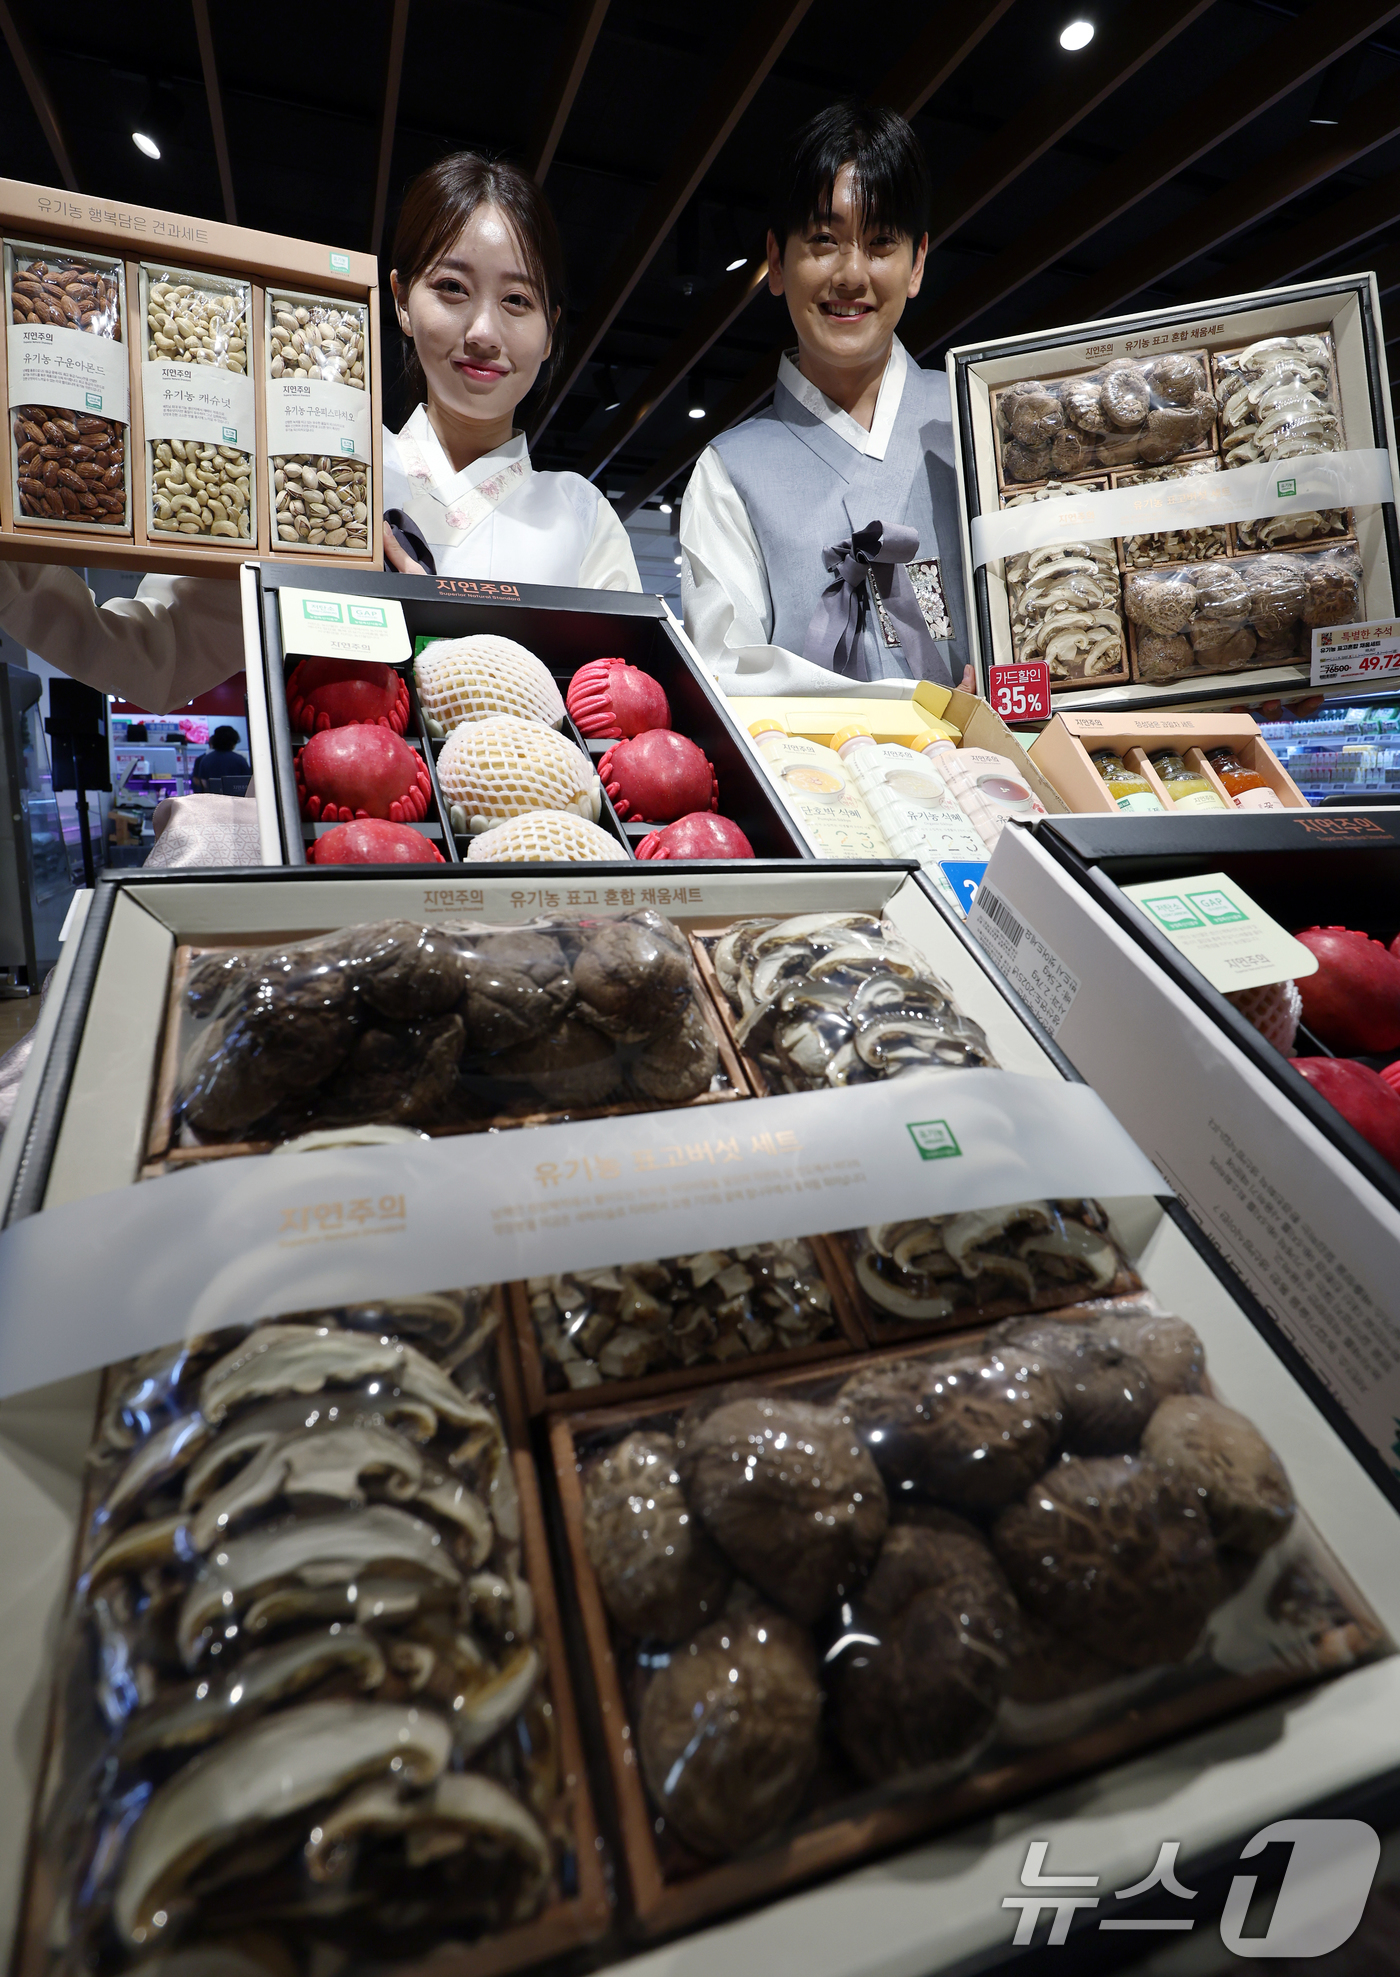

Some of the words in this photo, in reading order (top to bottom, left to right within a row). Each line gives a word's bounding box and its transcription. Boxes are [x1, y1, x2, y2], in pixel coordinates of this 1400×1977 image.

[37, 197, 83, 219] 유기농
[88, 207, 147, 232] 행복담은
[152, 220, 209, 244] 견과세트
[23, 331, 54, 342] 자연주의
[1085, 343, 1114, 356] 자연주의
[1124, 338, 1150, 352] 유기농
[1152, 334, 1169, 347] 표고
[1171, 330, 1188, 343] 혼합
[1190, 324, 1225, 339] 채움세트
[23, 353, 52, 366] 유기농
[54, 356, 106, 376] 구운아몬드
[162, 368, 192, 379] 자연주의
[283, 385, 311, 395] 자연주의
[163, 389, 195, 402] 유기농
[199, 392, 231, 409] 캐슈넛
[284, 405, 306, 417] 유기농
[306, 406, 355, 423] 구운피스타치오
[1133, 498, 1163, 511] 유기농
[1166, 489, 1208, 506] 표고버섯
[1211, 486, 1232, 498] 세트
[435, 579, 520, 597] 자연주의
[355, 609, 378, 617] GAP
[1341, 629, 1371, 642] 특별한
[1373, 626, 1393, 638] 추석
[330, 640, 371, 651] 자연주의
[996, 668, 1041, 685] 카드할인
[997, 685, 1042, 715] 35%
[782, 743, 815, 753] 자연주의
[883, 750, 913, 759] 자연주의
[971, 755, 1000, 763] 자연주의
[801, 805, 836, 817] 단호박
[839, 807, 861, 819] 식혜
[907, 810, 939, 822] 유기농
[941, 812, 963, 823] 식혜
[1293, 817, 1385, 834] 자연주의
[423, 889, 484, 906] 자연주의
[509, 890, 560, 908] 유기농
[565, 889, 600, 906] 표고
[603, 888, 636, 906] 혼합
[640, 886, 704, 906] 채움세트
[1200, 897, 1223, 908] GAP
[1155, 903, 1183, 913] 저탄소
[1021, 929, 1056, 968] 씻어드세요
[1224, 953, 1272, 969] 자연주의
[1031, 970, 1050, 996] 2.7kg
[1043, 965, 1062, 991] 2.5kg
[1056, 965, 1077, 992] 반드시
[1009, 966, 1060, 1025] 생산연도:2025년
[1063, 992, 1071, 1003] 배:
[1052, 996, 1066, 1013] 사과:
[534, 1156, 620, 1189] 유기농
[632, 1134, 745, 1175] 표고버섯
[750, 1127, 805, 1157] 세트
[278, 1193, 407, 1236] 자연주의
